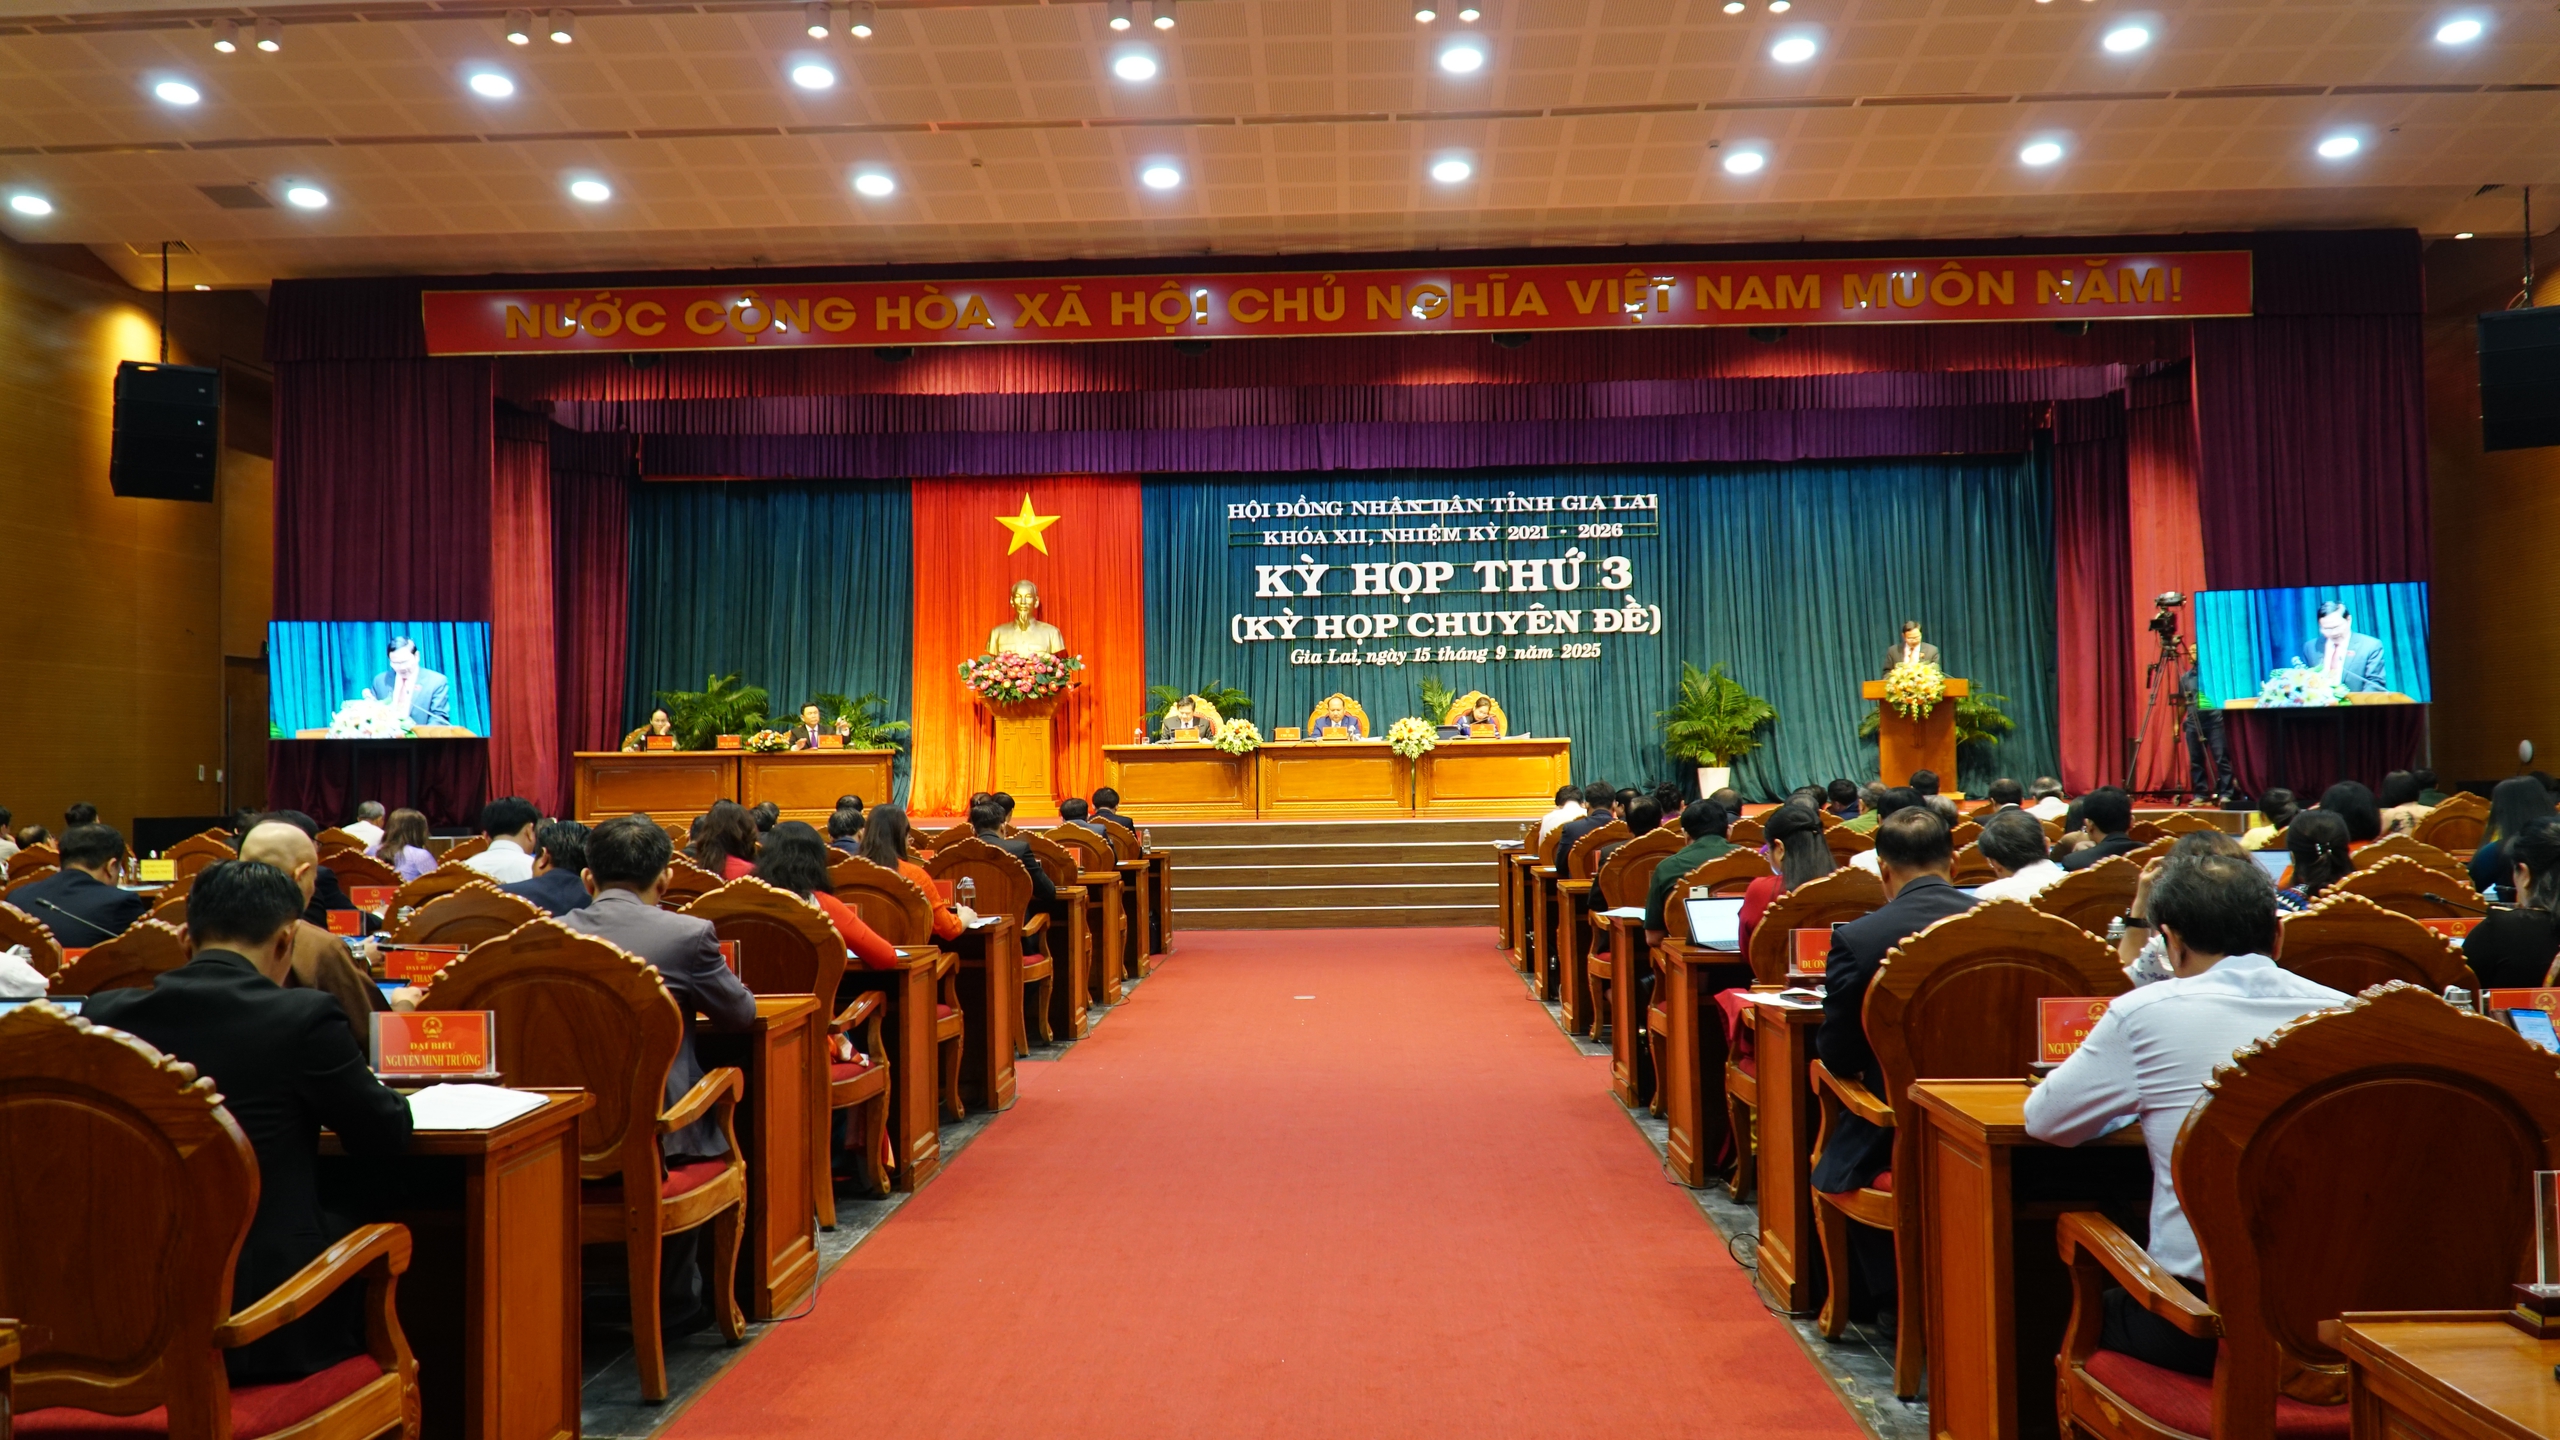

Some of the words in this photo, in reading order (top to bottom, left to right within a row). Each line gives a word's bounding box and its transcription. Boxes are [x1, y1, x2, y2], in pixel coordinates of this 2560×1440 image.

[506, 290, 668, 340] NƯỚC
[684, 290, 858, 344] CỘNG
[875, 284, 997, 331] HÒA
[1014, 284, 1092, 328] XÃ
[1110, 279, 1209, 334] HỘI
[1227, 273, 1346, 324] CHỦ
[1366, 272, 1550, 321] NGHĨA
[1565, 267, 1677, 324] VIỆT
[1696, 274, 1821, 312] NAM
[1842, 260, 2015, 309] MUÔN
[2036, 258, 2182, 306] NĂM!
[1227, 499, 1271, 523] HỘI
[1276, 494, 1344, 518] ĐỒNG
[1351, 495, 1427, 516] NHÂN
[1432, 494, 1485, 514] DÂN
[1491, 490, 1555, 513] TỈNH
[1561, 494, 1606, 511] GIA
[1613, 493, 1658, 510] LAI
[1263, 525, 1329, 546] KHÓA
[1332, 528, 1374, 547] XII,
[1381, 522, 1462, 546] NHIỆM
[1468, 521, 1501, 542] KỲ
[1507, 525, 1550, 541] 2021
[1578, 522, 1624, 539] 2026
[1255, 552, 1330, 598] KỲ
[1351, 561, 1455, 604] HỌP
[1472, 546, 1587, 594] THỨ
[1601, 555, 1633, 591] 3
[1231, 606, 1304, 645] (KỲ
[1313, 613, 1400, 646] HỌP
[1406, 602, 1582, 638] CHUYÊN
[1591, 593, 1662, 636] ĐỀ)
[1290, 648, 1323, 666] Gia
[1327, 648, 1362, 667] Lai,
[1366, 647, 1408, 668] ngày
[1412, 646, 1432, 663] 15
[1437, 644, 1489, 664] tháng
[1495, 645, 1507, 661] 9
[1513, 645, 1554, 661] năm
[1560, 642, 1602, 659] 2025
[1802, 959, 1826, 969] DƯƠN
[413, 974, 434, 983] THAN
[2047, 1039, 2082, 1055] NGUYỄ
[421, 1054, 444, 1067] MINH
